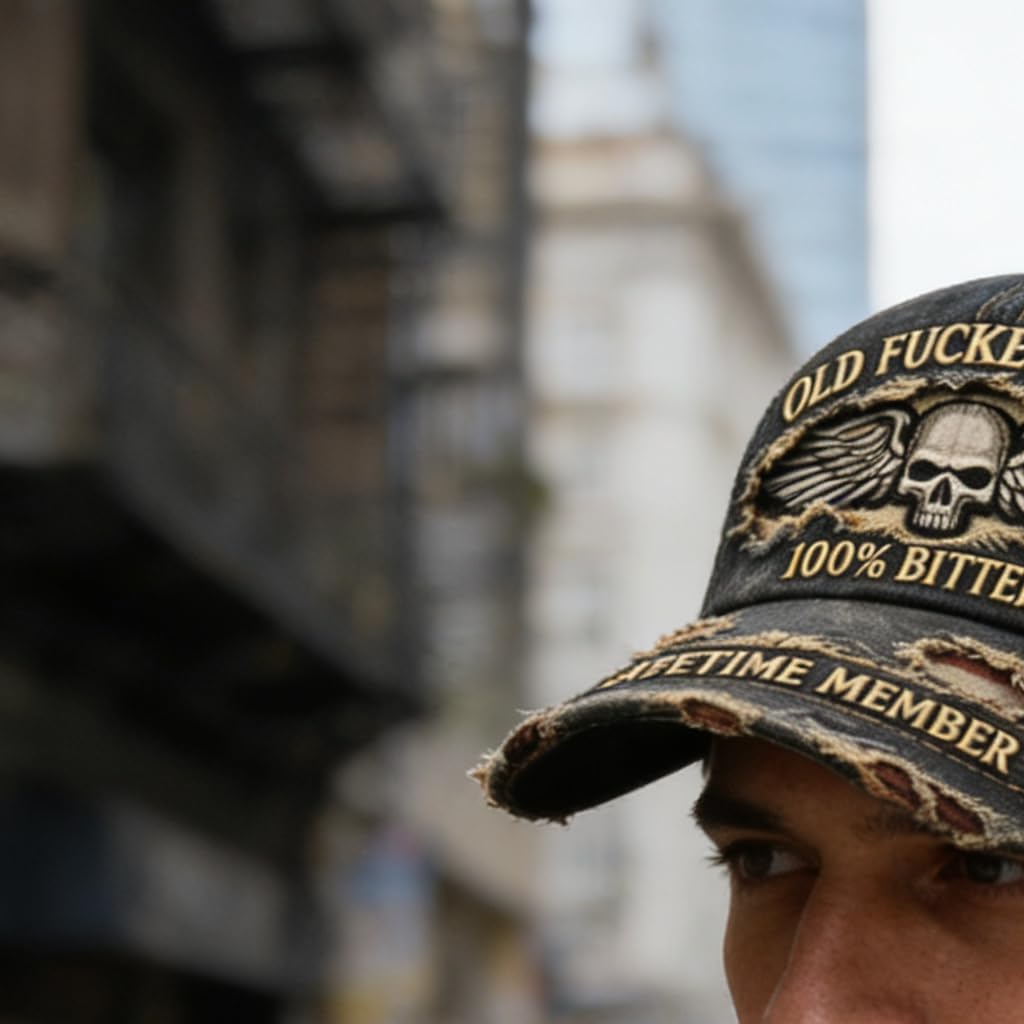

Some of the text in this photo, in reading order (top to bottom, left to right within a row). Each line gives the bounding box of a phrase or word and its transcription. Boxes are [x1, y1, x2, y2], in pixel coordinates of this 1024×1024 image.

[782, 349, 865, 423] OLD
[780, 540, 888, 581] 100%
[815, 667, 1021, 774] MEMBER
